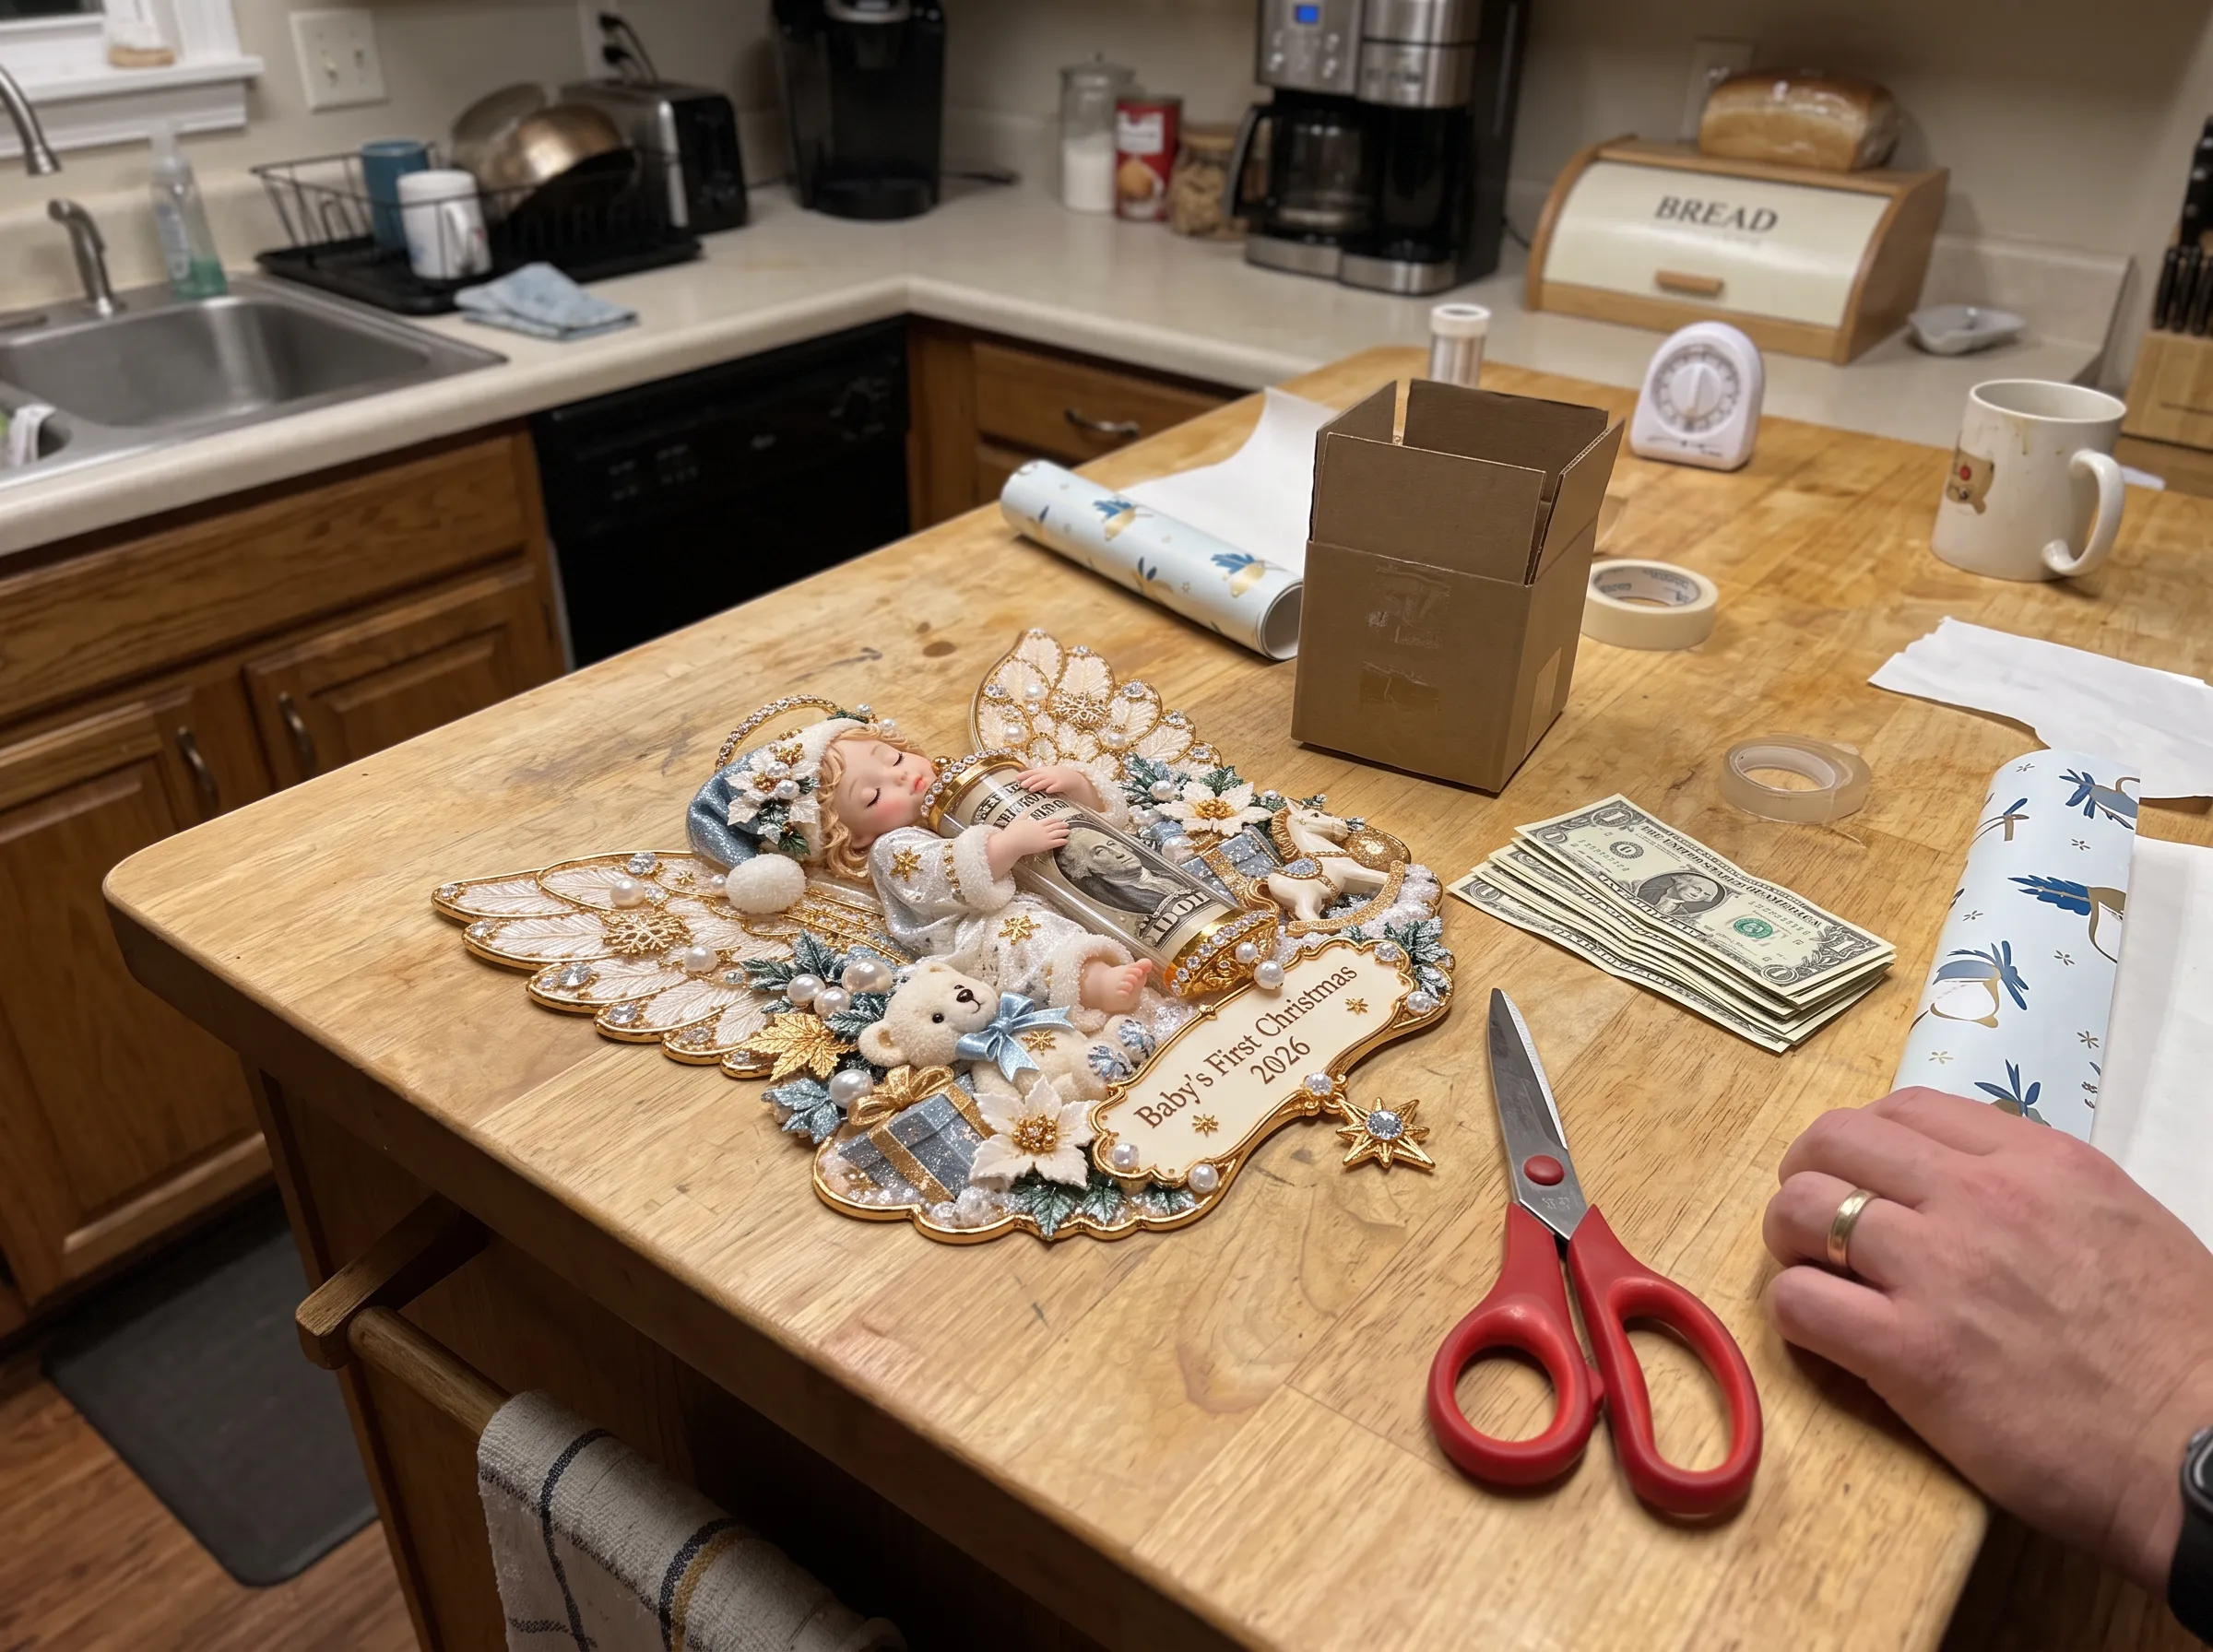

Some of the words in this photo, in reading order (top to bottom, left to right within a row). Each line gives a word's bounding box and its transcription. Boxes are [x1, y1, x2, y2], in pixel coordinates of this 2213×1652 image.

[1654, 195, 1779, 232] BREAD
[1133, 1073, 1214, 1129] Baby's
[1203, 1034, 1262, 1077] First
[1255, 965, 1358, 1037] Christmas
[1250, 1035, 1311, 1085] 2026
